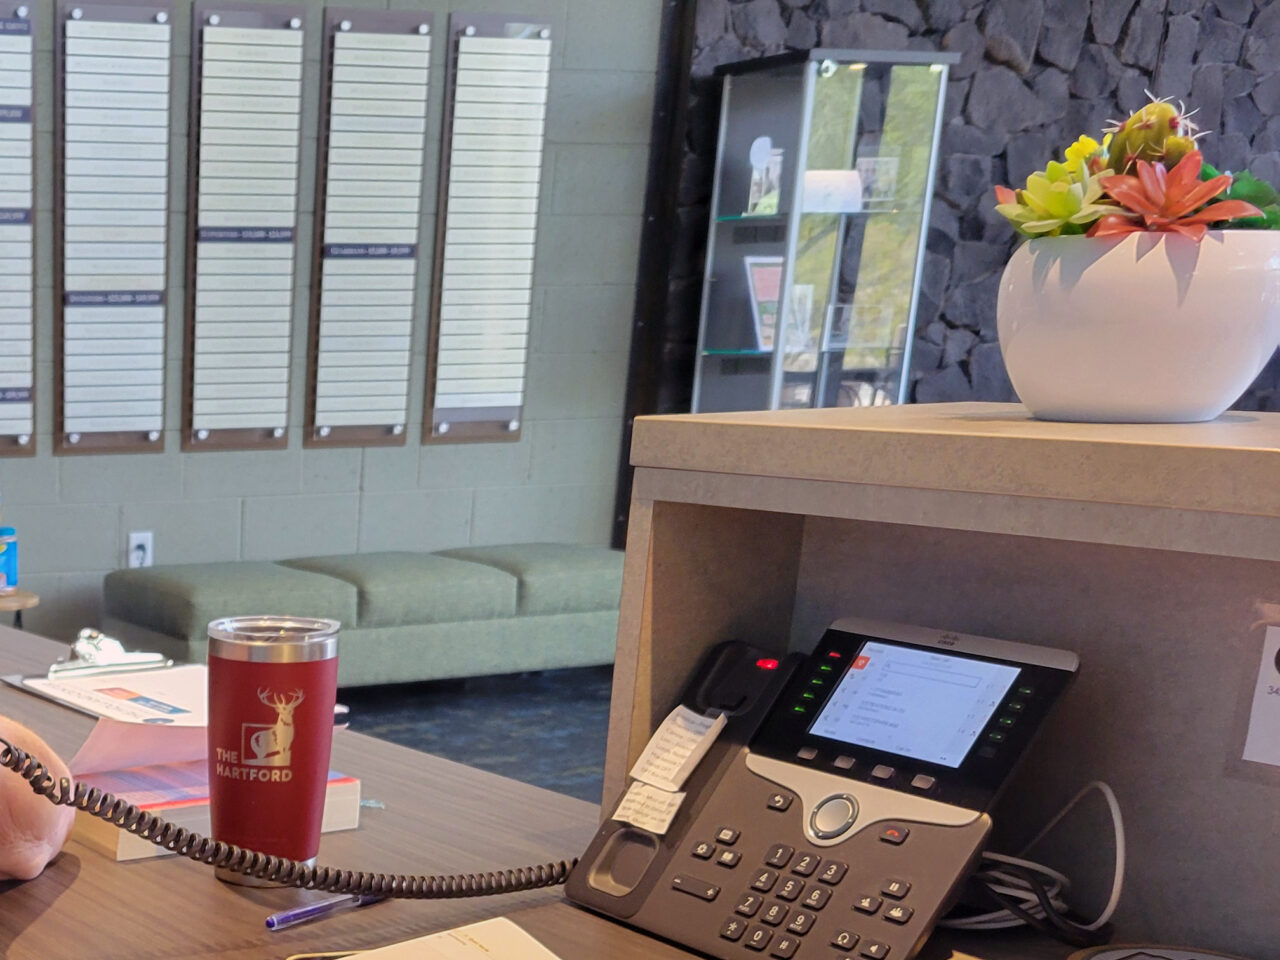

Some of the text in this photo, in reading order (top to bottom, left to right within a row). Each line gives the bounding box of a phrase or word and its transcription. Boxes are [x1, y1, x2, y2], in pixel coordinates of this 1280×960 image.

[216, 747, 238, 764] THE
[216, 763, 292, 782] HARTFORD
[800, 857, 810, 867] 2
[827, 865, 837, 875] 3
[760, 873, 820, 900] 4 5 6
[744, 897, 805, 925] 7 8 9
[753, 931, 763, 941] 0
